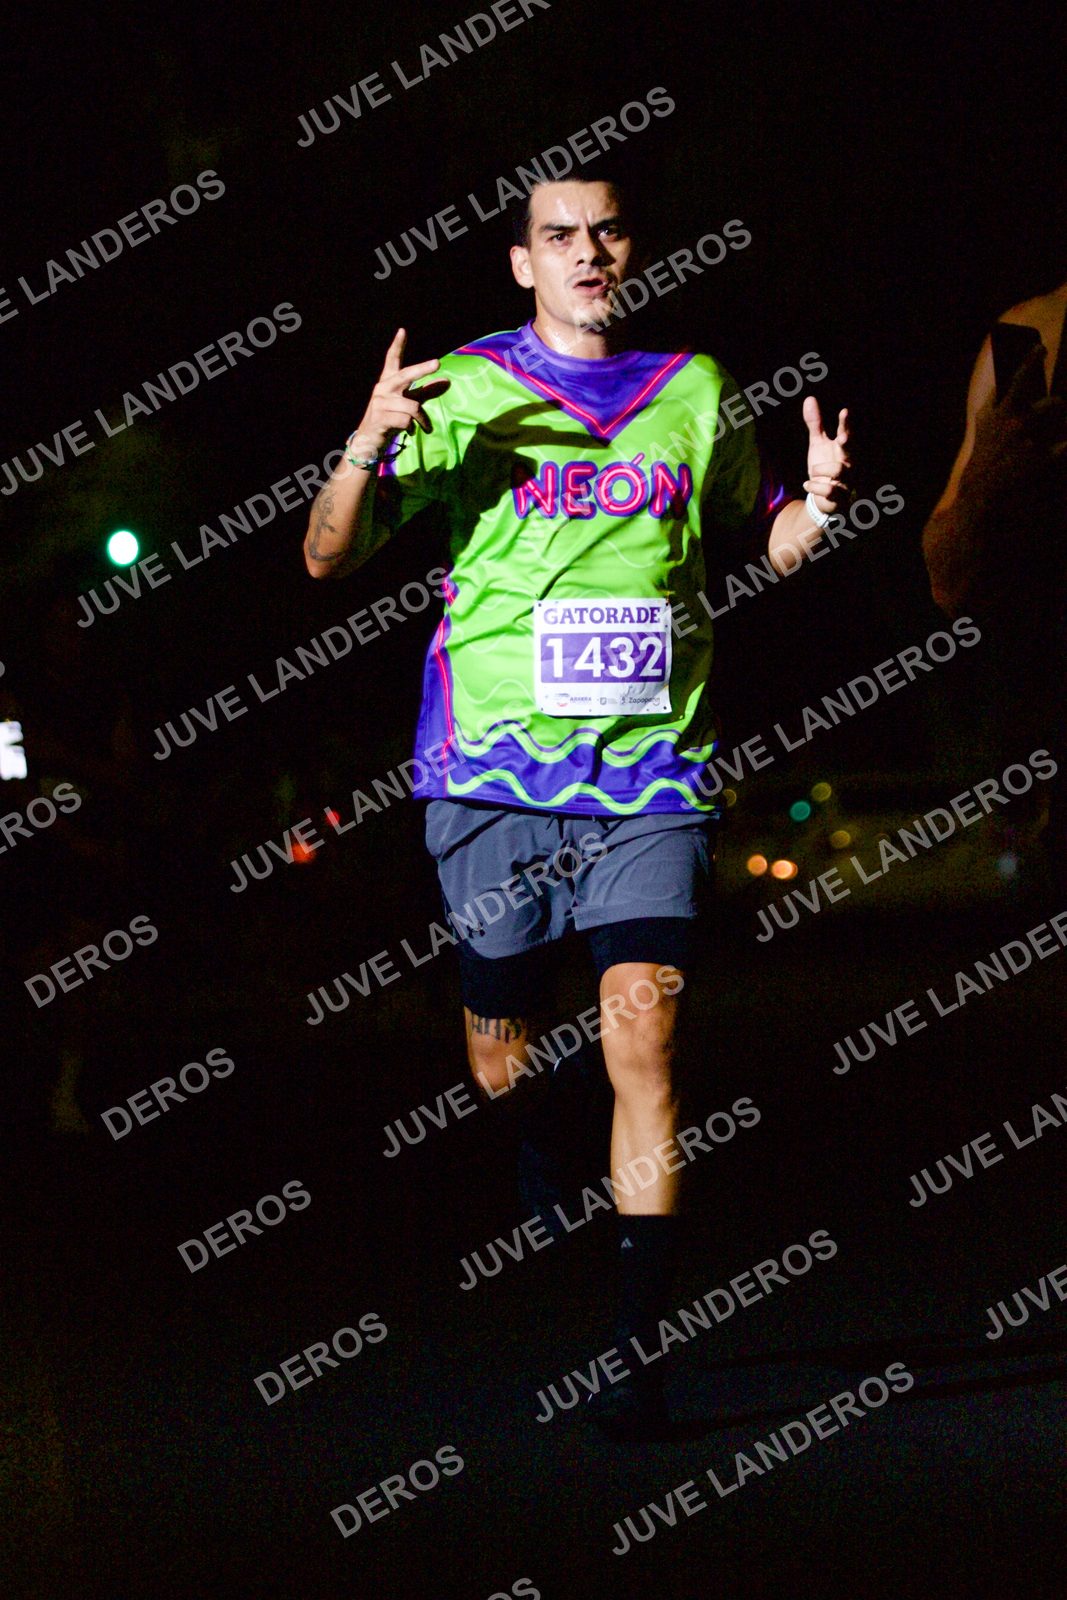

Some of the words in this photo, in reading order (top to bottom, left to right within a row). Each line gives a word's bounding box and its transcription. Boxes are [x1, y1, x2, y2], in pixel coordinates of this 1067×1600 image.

[511, 452, 693, 520] NEÓN
[543, 607, 661, 624] GATORADE
[546, 637, 663, 678] 1432
